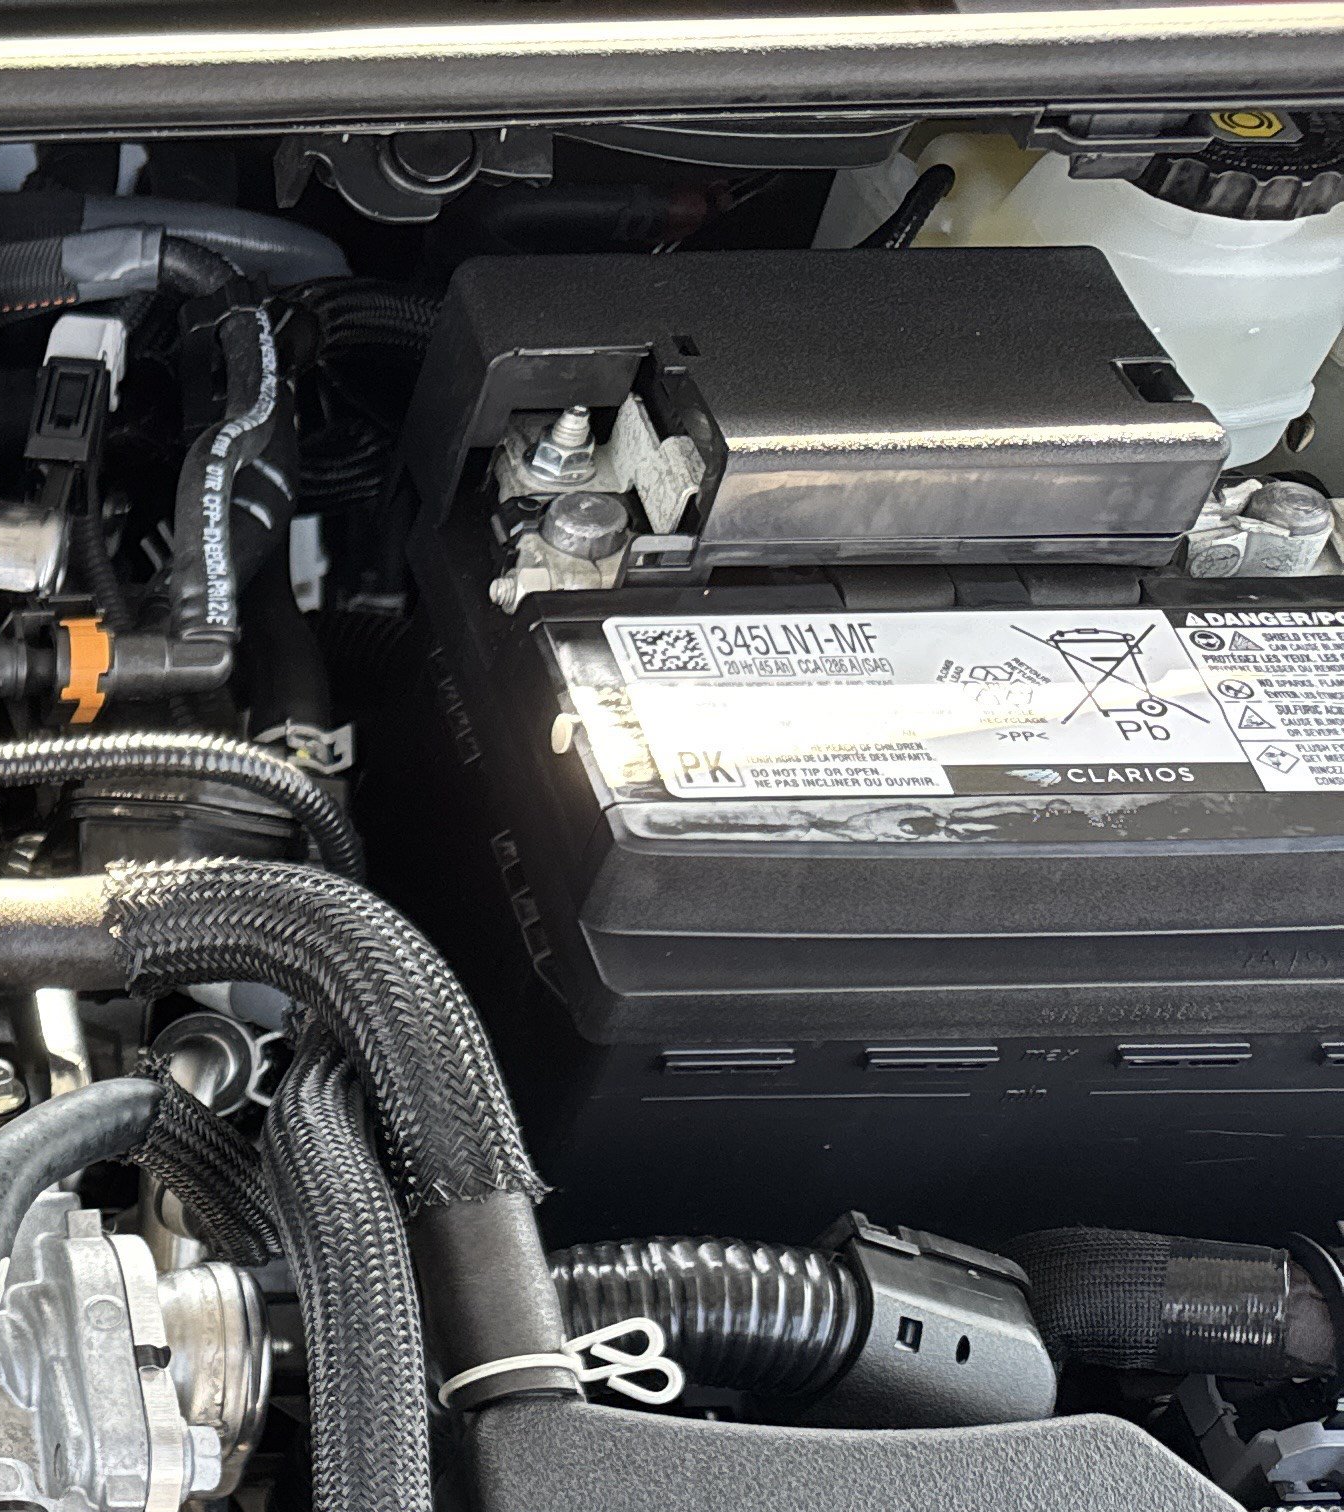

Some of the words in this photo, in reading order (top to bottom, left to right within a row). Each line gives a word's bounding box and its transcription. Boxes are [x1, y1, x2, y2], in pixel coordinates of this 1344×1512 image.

[711, 622, 878, 657] 345LN1-MF
[995, 731, 1050, 742] >PP<
[1115, 720, 1172, 742] Pb
[677, 750, 737, 784] PK
[772, 768, 798, 777] NOT
[800, 768, 821, 777] TIP
[824, 768, 843, 776] OR
[1066, 766, 1196, 784] CLARIOS
